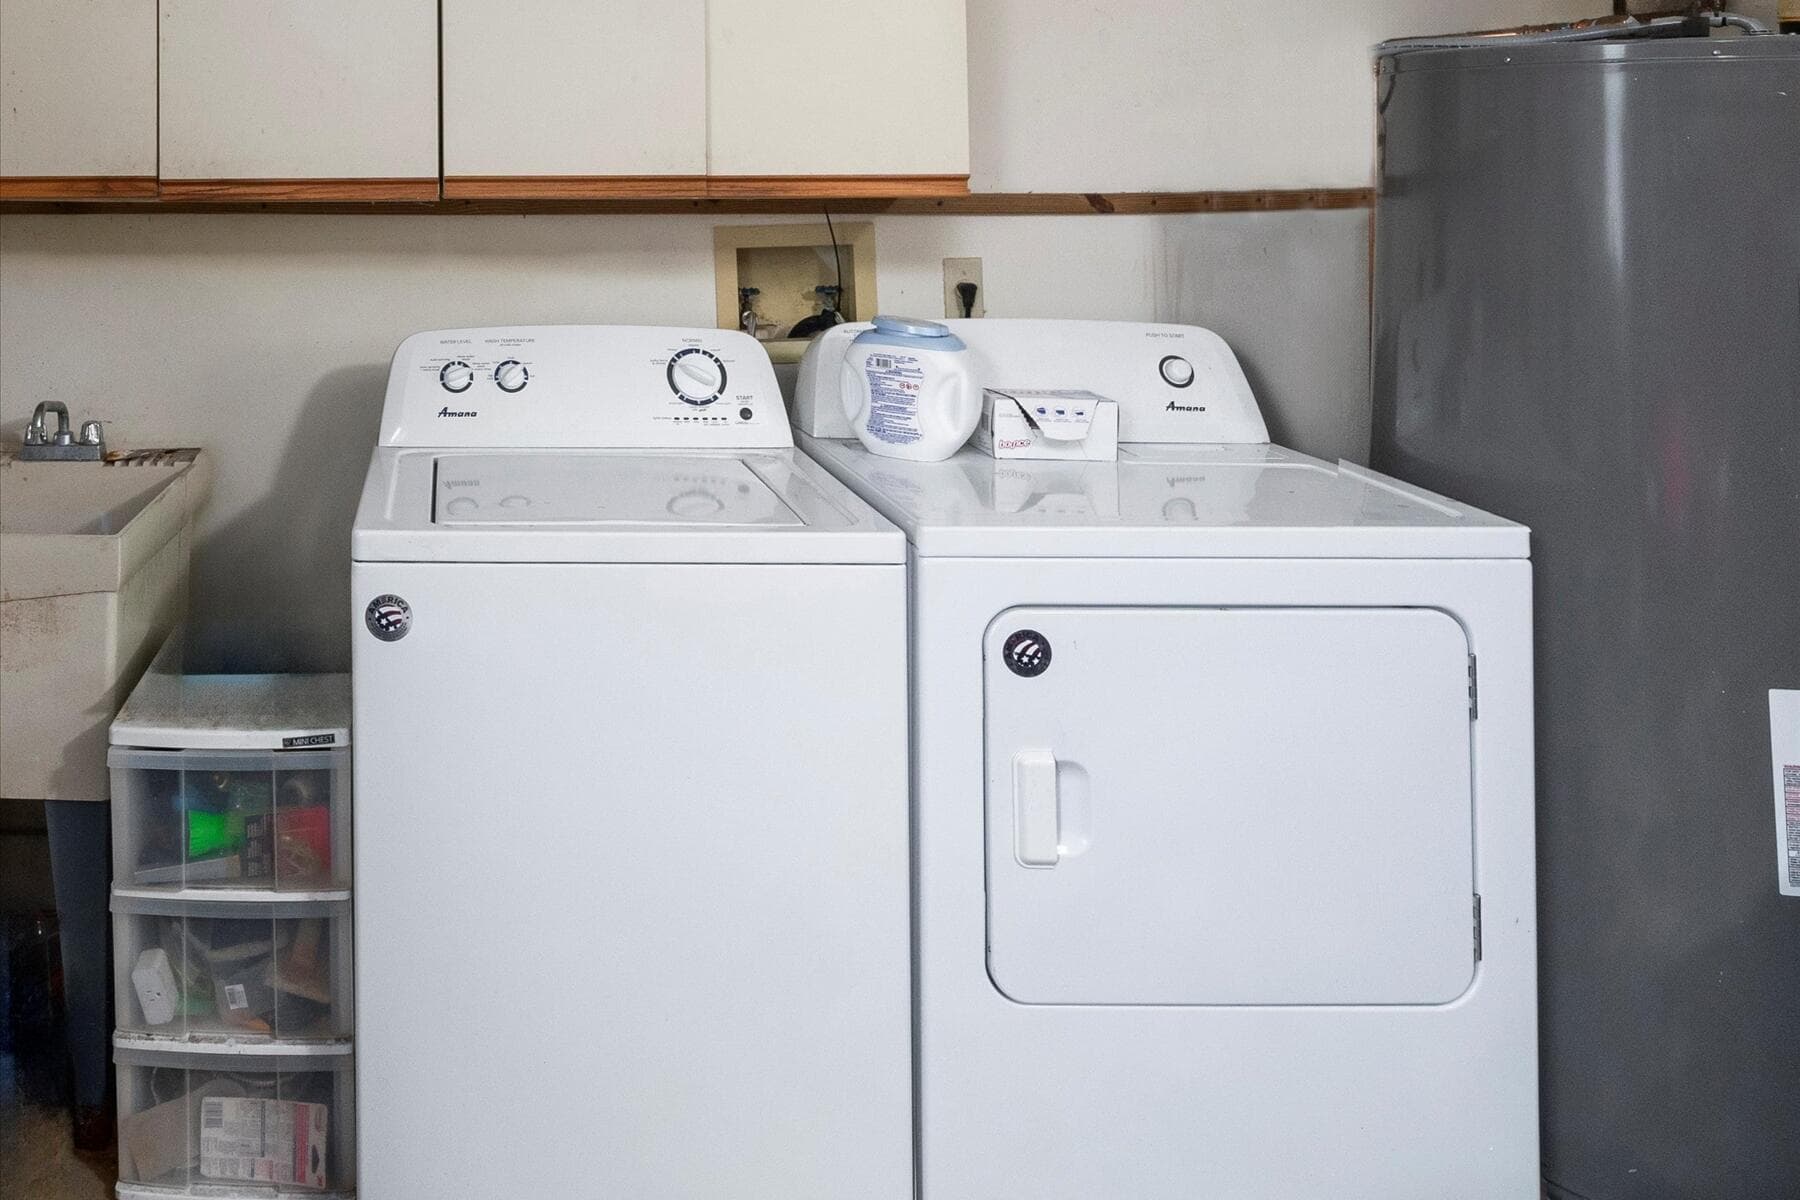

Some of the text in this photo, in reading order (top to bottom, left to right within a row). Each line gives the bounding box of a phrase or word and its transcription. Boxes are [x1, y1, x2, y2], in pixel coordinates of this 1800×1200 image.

[437, 406, 478, 418] Amana
[1166, 400, 1206, 412] Amana
[292, 735, 333, 746] MINI CHEST
